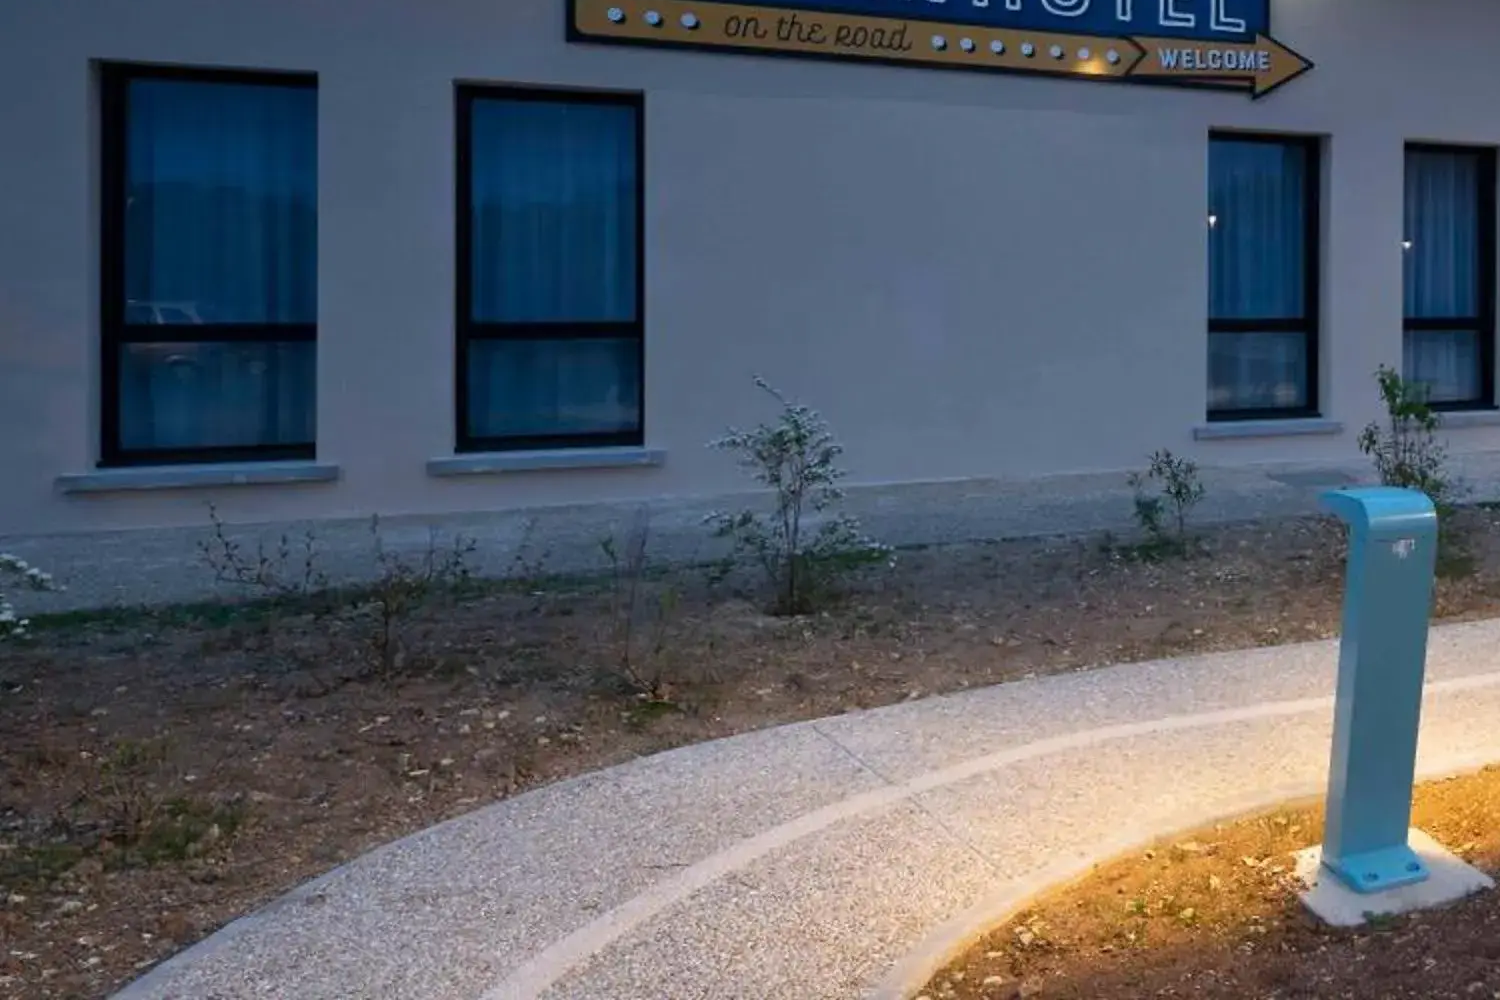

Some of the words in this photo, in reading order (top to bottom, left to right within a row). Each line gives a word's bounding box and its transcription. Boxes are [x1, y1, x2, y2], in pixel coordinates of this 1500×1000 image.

[724, 14, 768, 40] on
[776, 11, 827, 45] the
[1157, 47, 1272, 70] WELCOME
